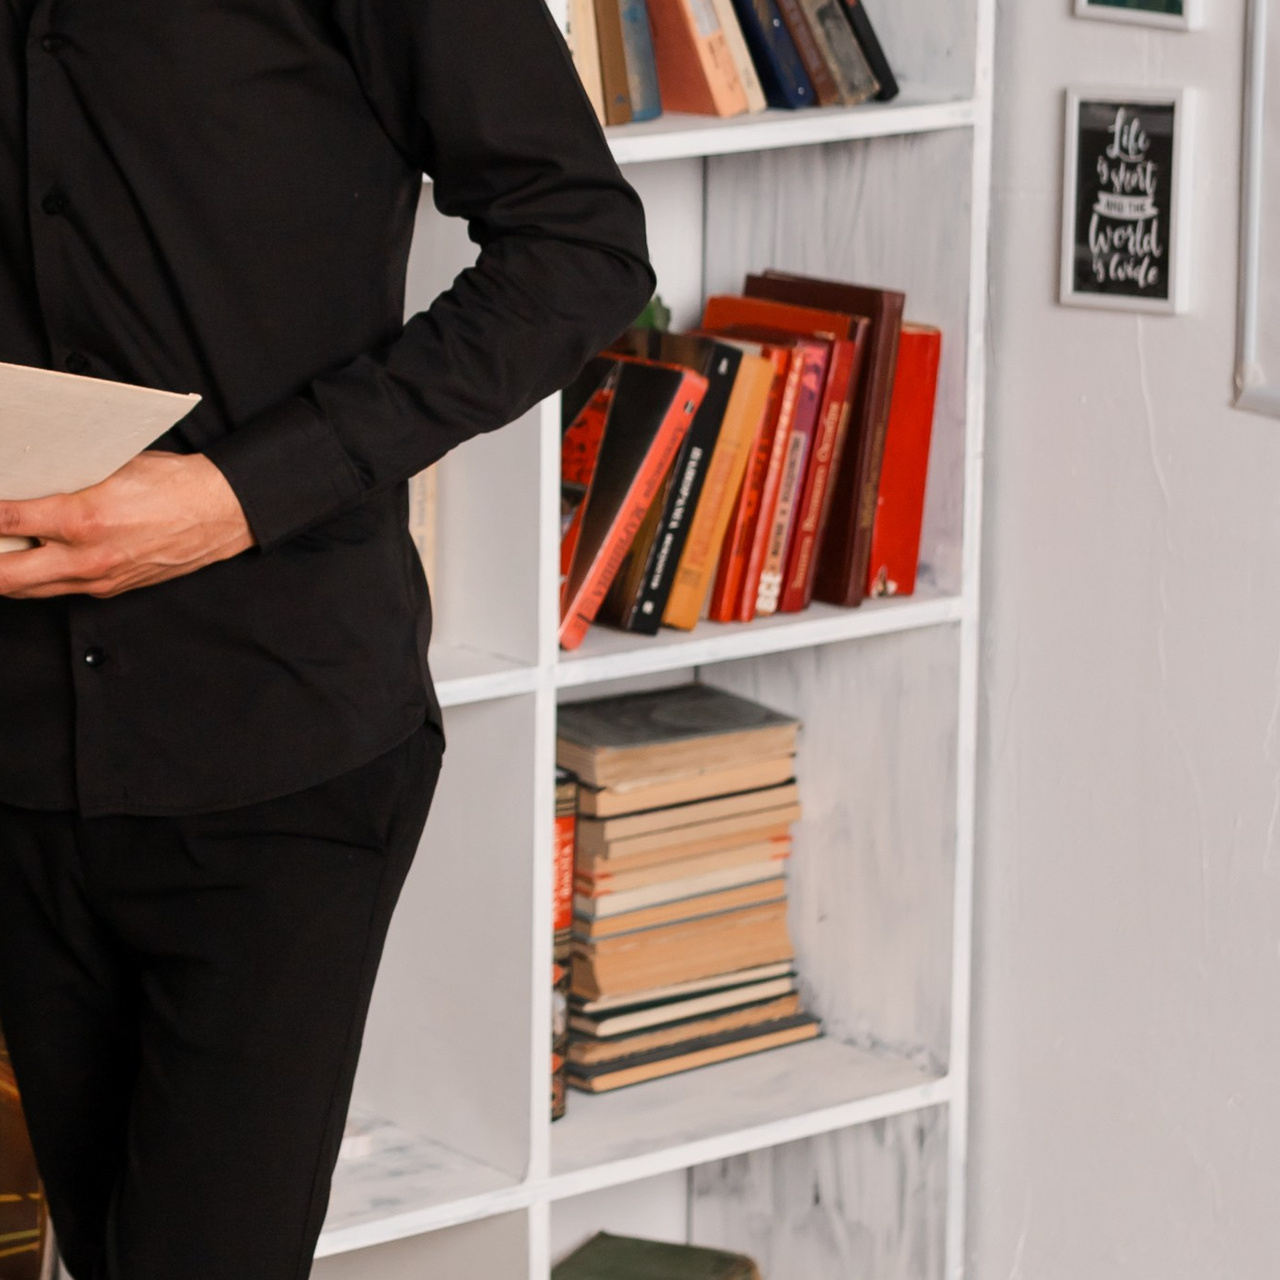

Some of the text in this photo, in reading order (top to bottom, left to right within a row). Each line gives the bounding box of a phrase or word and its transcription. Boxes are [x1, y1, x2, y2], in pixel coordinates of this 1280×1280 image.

[1106, 107, 1150, 162] Life
[1111, 161, 1158, 195] short
[1103, 199, 1147, 213] AND THE
[753, 570, 783, 615] ВСЕ
